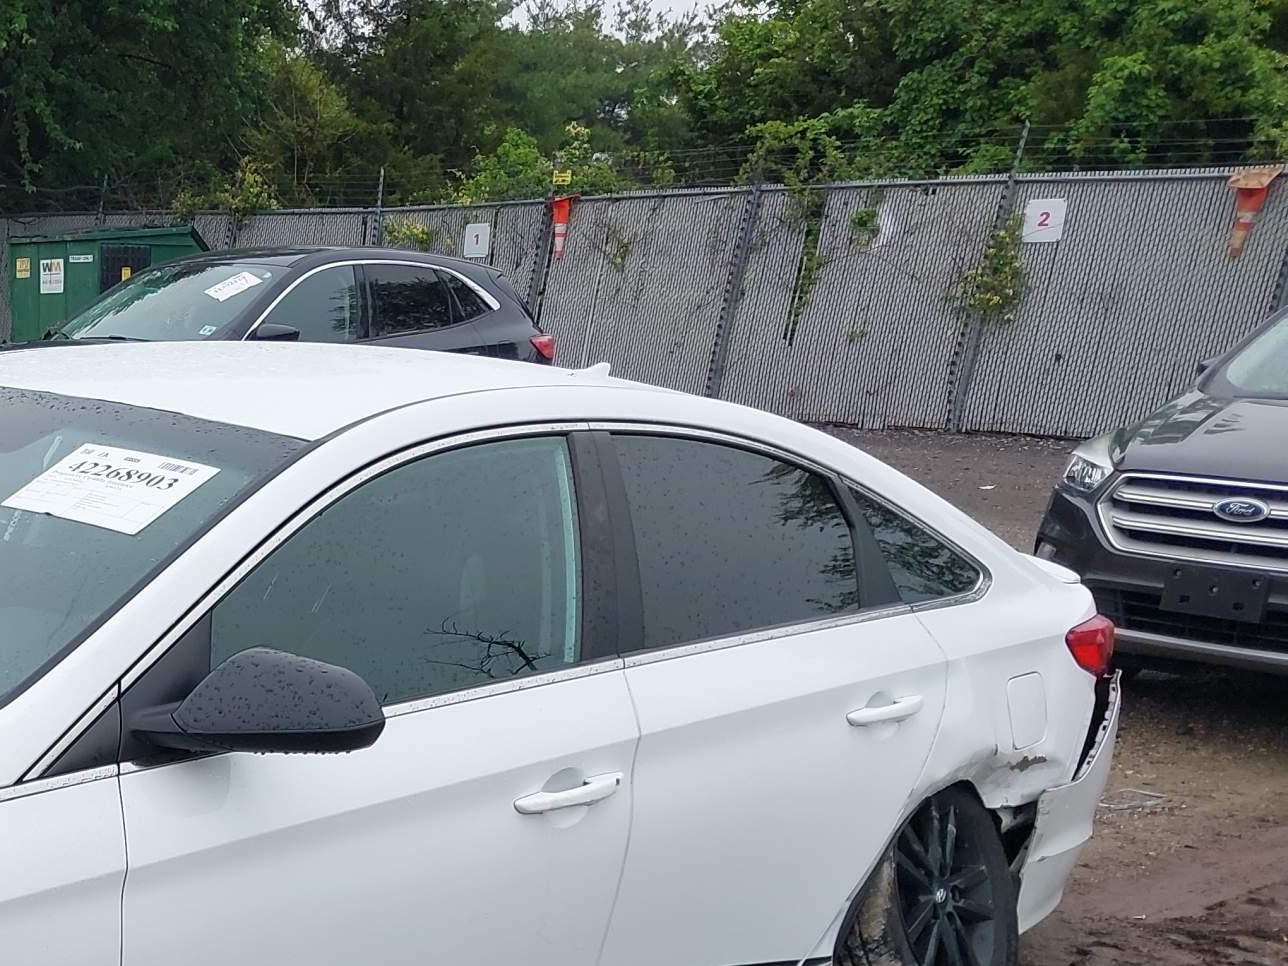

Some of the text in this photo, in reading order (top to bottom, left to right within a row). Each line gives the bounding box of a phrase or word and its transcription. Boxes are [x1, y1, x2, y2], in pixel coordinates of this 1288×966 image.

[1037, 211, 1051, 227] 2
[473, 233, 480, 246] 1
[42, 261, 62, 273] WM
[68, 460, 180, 491] 42268903
[1225, 502, 1256, 516] Ford
